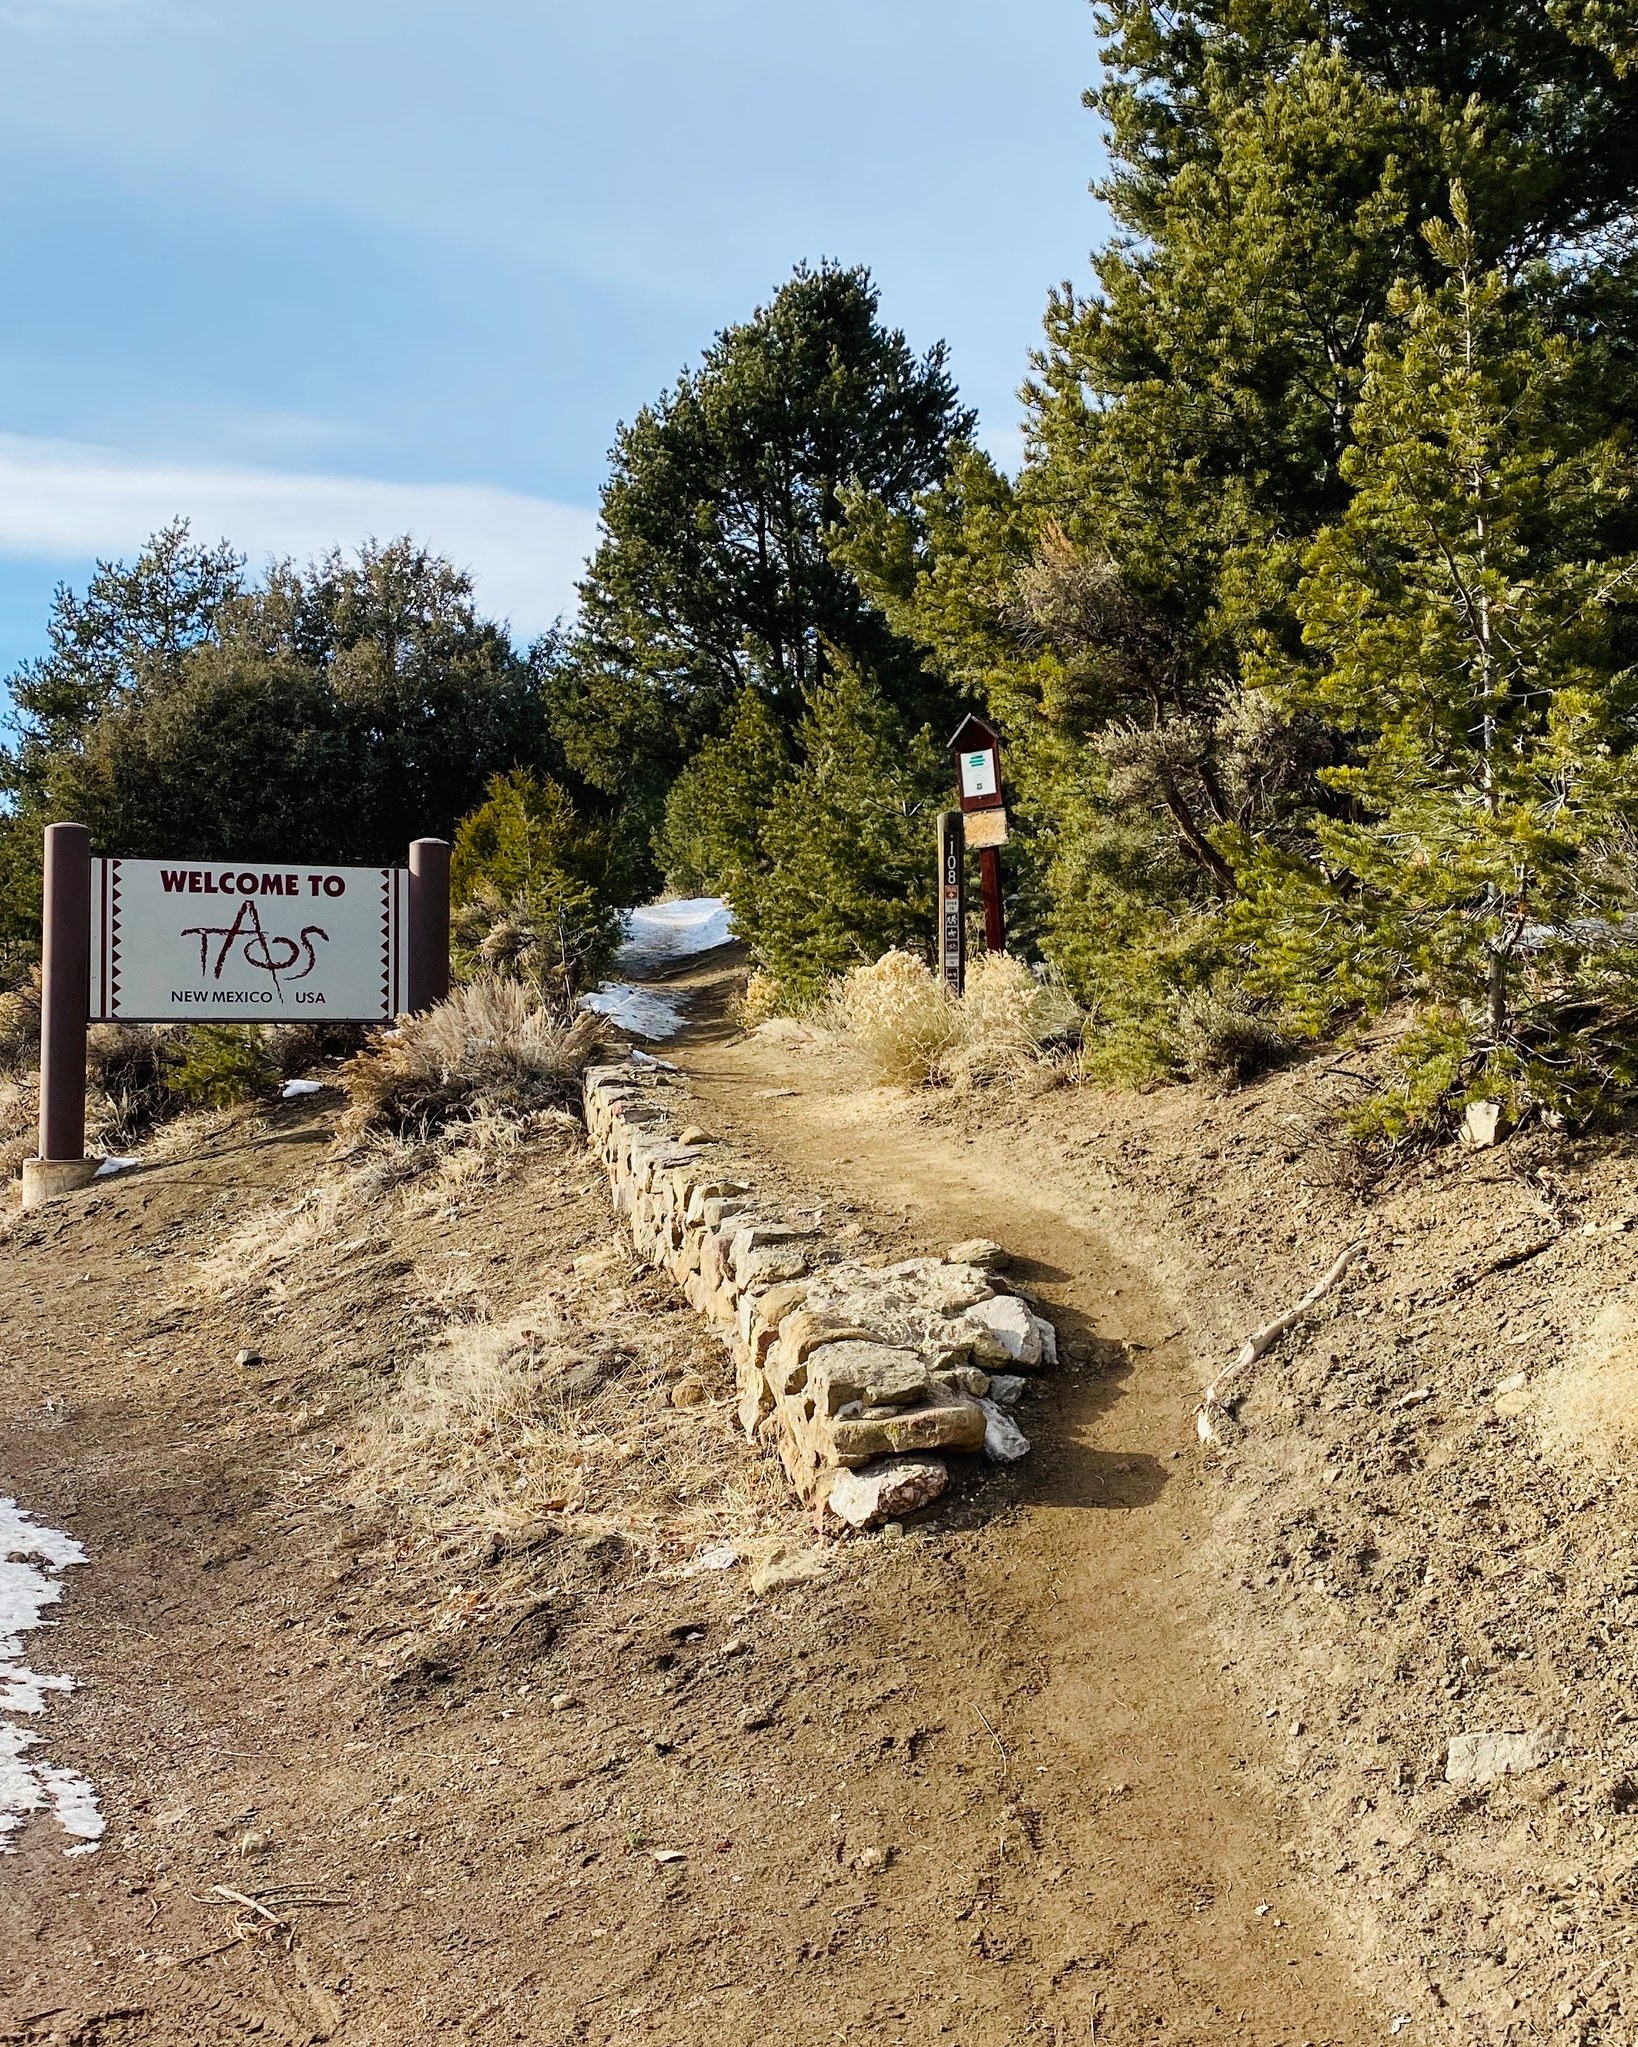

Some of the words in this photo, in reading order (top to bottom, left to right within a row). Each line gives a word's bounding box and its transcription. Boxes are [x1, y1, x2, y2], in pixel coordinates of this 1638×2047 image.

[947, 840, 957, 885] 108
[160, 869, 299, 896] WELCOME
[307, 874, 346, 897] TO
[180, 899, 330, 1004] TAOS
[171, 990, 208, 1003] NEW
[211, 990, 273, 1004] MEXICO
[295, 991, 326, 1004] USA
